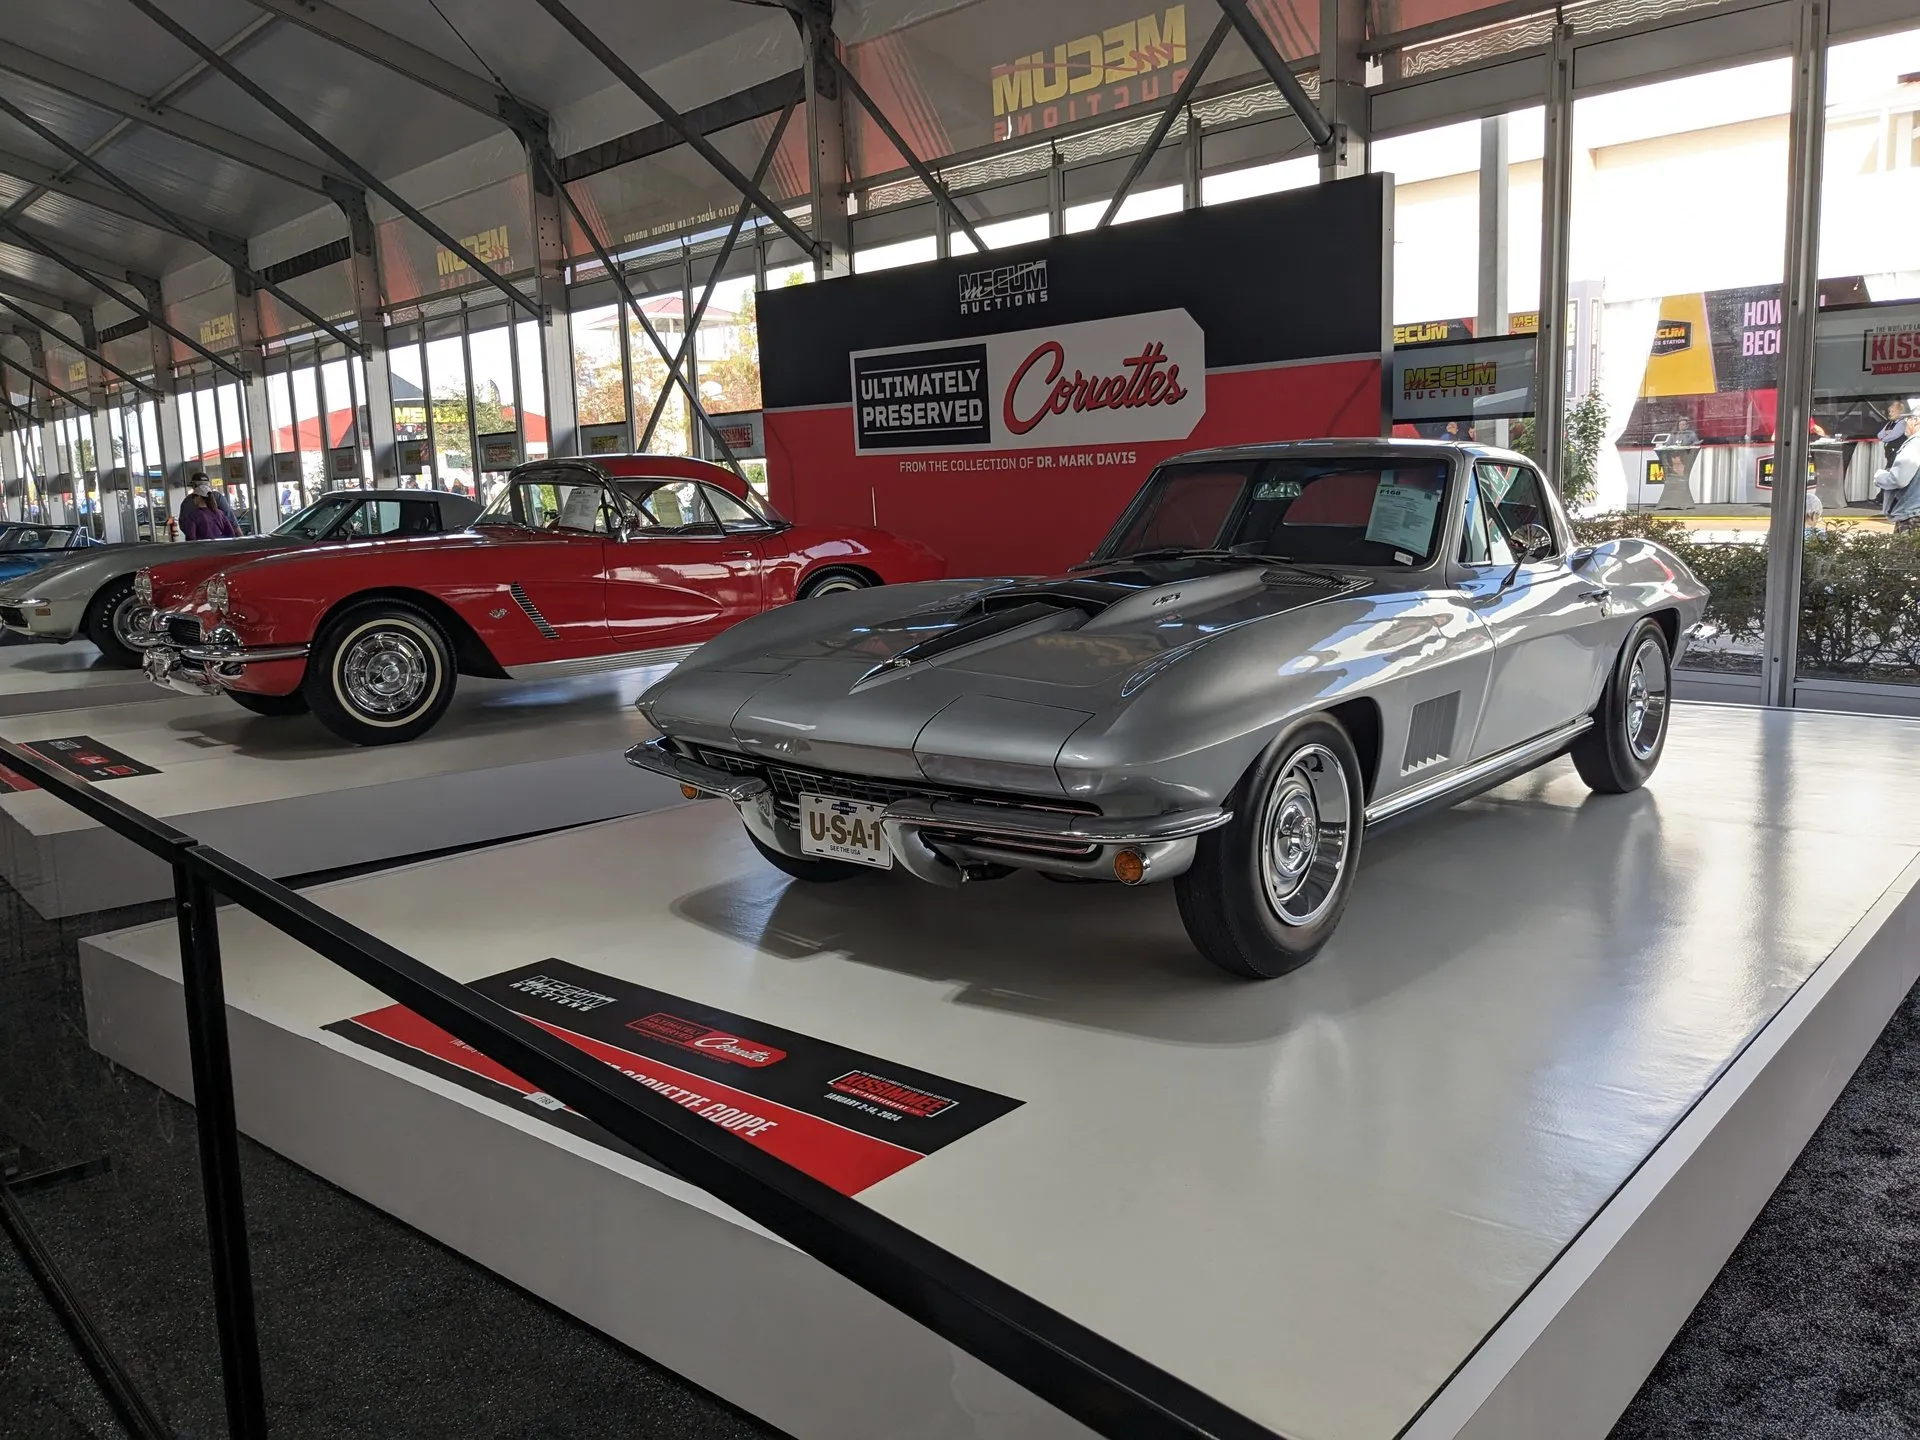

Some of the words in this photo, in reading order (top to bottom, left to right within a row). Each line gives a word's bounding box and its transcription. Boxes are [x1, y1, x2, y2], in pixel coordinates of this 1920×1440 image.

[959, 260, 1048, 302] MECUM
[960, 290, 1048, 314] AUCTIONS
[1394, 323, 1448, 343] ECUM
[1512, 314, 1539, 328] MEC
[861, 368, 980, 400] ULTIMATELY
[1003, 340, 1187, 435] Corvettes
[1403, 362, 1496, 391] MECUM
[1404, 385, 1496, 400] AUCTIONS
[862, 398, 983, 428] PRESERVED
[900, 460, 927, 473] FROM
[928, 460, 948, 472] THE
[951, 457, 1017, 471] COLLECTION
[1019, 456, 1034, 469] OF
[1036, 455, 1056, 468] DR.
[1059, 453, 1094, 467] MARK
[1097, 451, 1137, 466] DAVIS
[830, 844, 839, 852] SEE
[509, 982, 593, 1012] AUCTIONS
[823, 1092, 860, 1108] JANUARY
[877, 1110, 903, 1122] 2024
[838, 1073, 949, 1112] KISSIMMEE
[697, 1102, 779, 1137] COUPE
